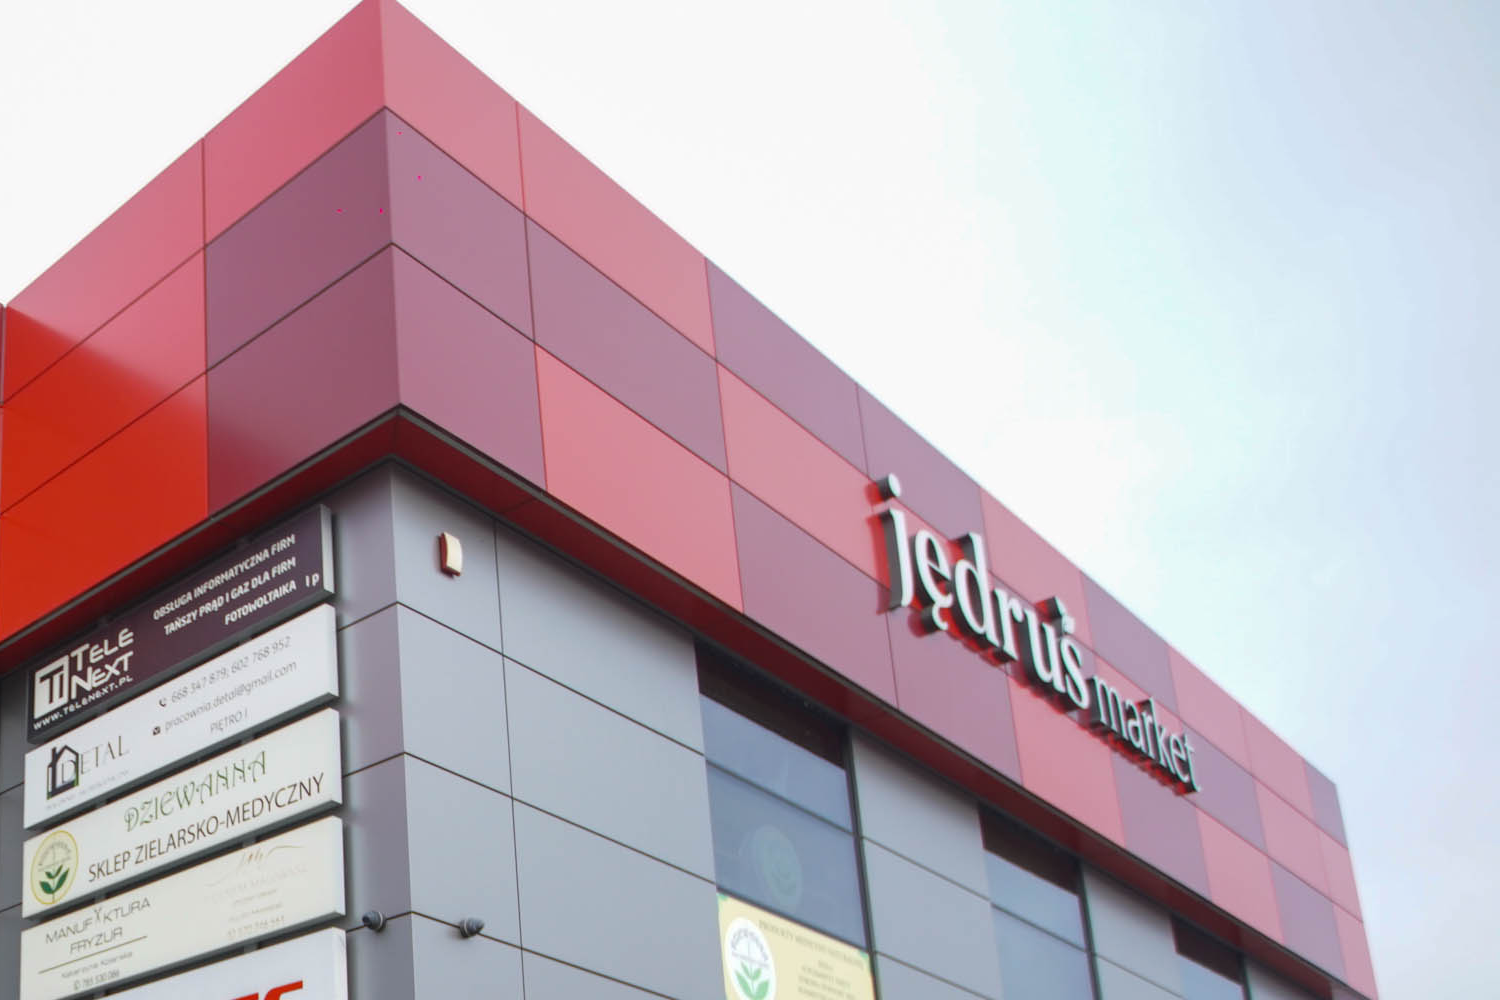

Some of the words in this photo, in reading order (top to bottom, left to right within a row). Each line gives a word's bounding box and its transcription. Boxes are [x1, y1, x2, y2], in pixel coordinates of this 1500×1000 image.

[152, 589, 193, 621] OBSŁUGA
[193, 549, 270, 599] INFORMATYCZNA
[271, 533, 296, 556] FIRM
[163, 610, 198, 636] TAŃSZY
[199, 595, 224, 618] PRĄD
[225, 592, 230, 603] I
[231, 581, 250, 600] GAZ
[251, 573, 271, 590] DLA
[271, 556, 296, 579] FIRM
[224, 579, 297, 626] FOTOWOLTAIKA
[70, 628, 134, 672] TELE
[882, 472, 1089, 711] jędruś
[1091, 674, 1201, 793] market
[71, 651, 134, 700] NEXT
[88, 851, 131, 882] SKLEP
[135, 772, 324, 865] ZIELARSKO-MEDYCZNY
[123, 750, 267, 832] DZIEWANNA
[70, 926, 123, 954] FRYZUR
